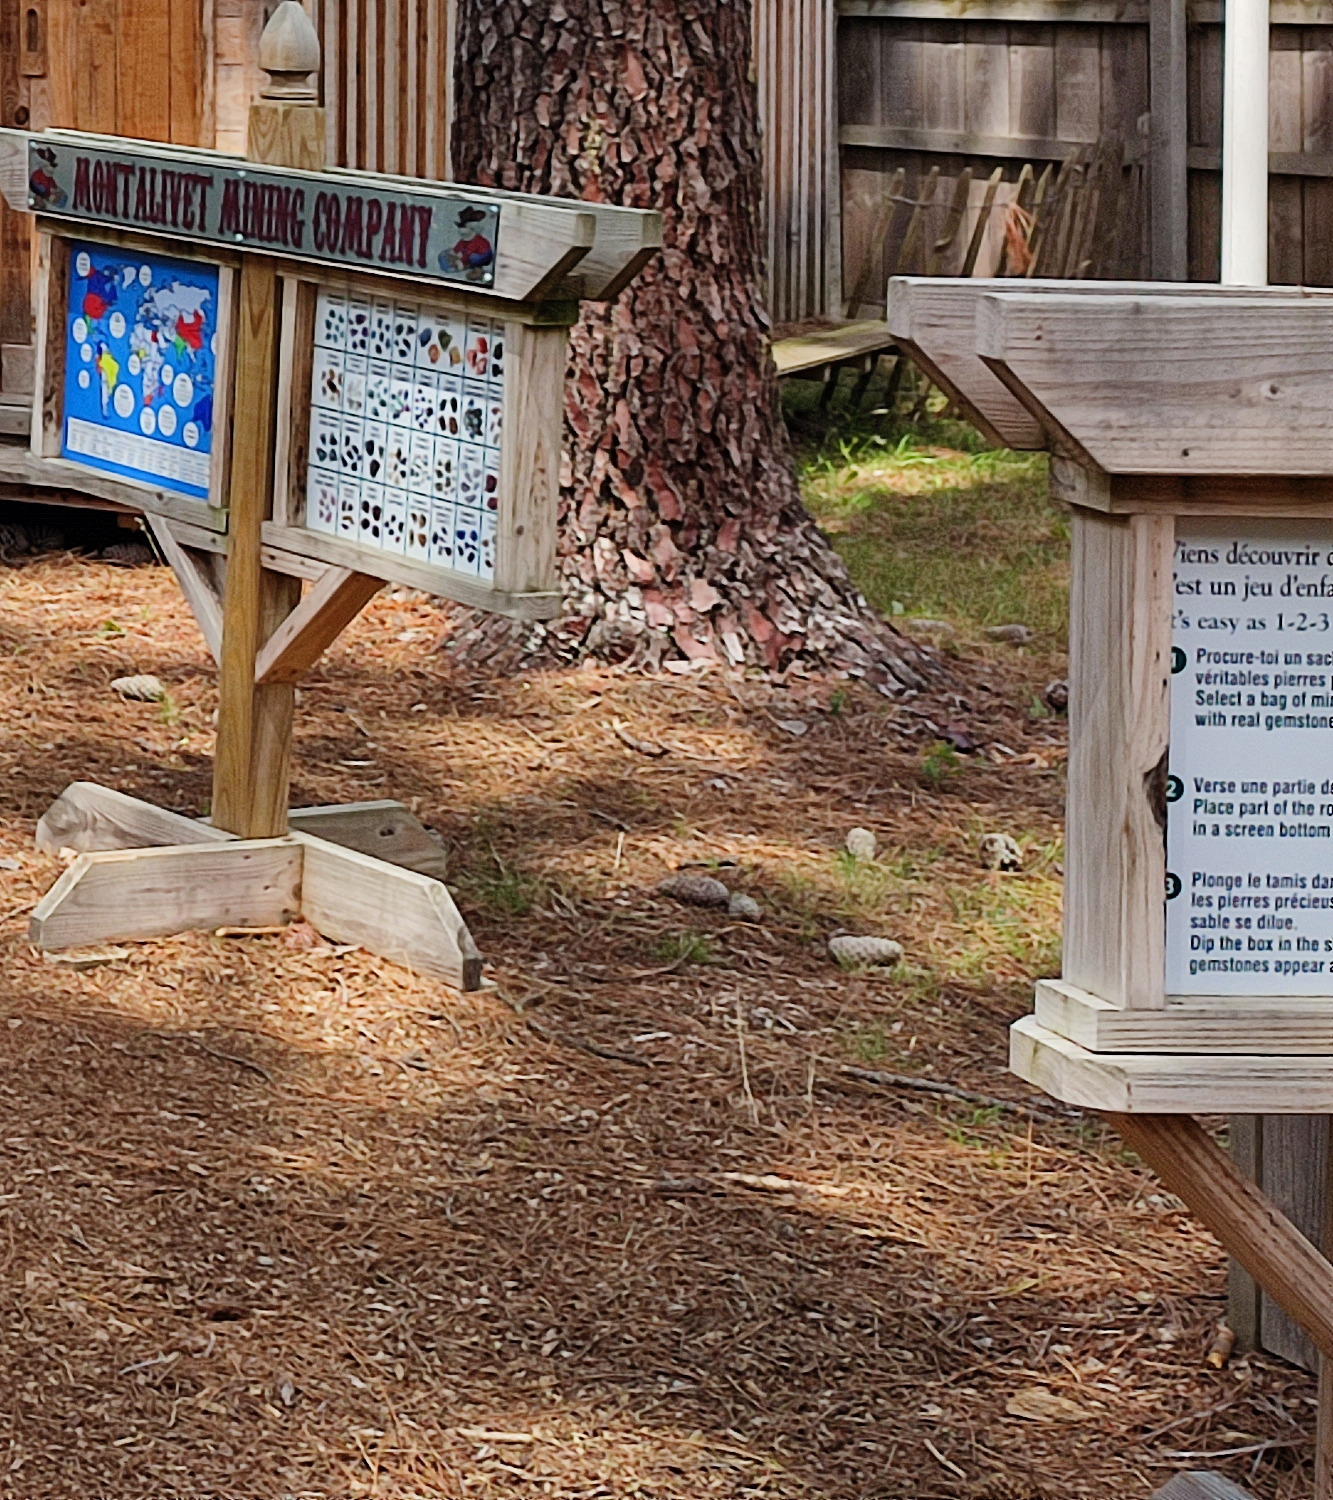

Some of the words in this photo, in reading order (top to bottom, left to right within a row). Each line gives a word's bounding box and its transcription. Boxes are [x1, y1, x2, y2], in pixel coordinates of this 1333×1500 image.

[72, 156, 214, 232] MONTALIVET
[218, 177, 306, 249] MINING
[312, 190, 433, 269] COMPANY
[1226, 541, 1320, 566] découvrir
[1172, 572, 1202, 595] 'est
[1210, 580, 1236, 596] un
[1241, 574, 1273, 602] jeu
[1171, 609, 1190, 629] t's
[1197, 615, 1238, 635] easy
[1246, 616, 1267, 630] as
[1276, 612, 1330, 632] 1-2-3
[1196, 648, 1279, 665] Procure-toi
[1284, 652, 1302, 665] un
[1306, 650, 1333, 666] sac
[1195, 669, 1269, 687] véritables
[1274, 670, 1326, 690] pierres
[1195, 689, 1242, 707] Select
[1246, 693, 1255, 706] a
[1260, 690, 1287, 711] bag
[1292, 691, 1307, 708] of
[1195, 711, 1226, 727] with
[1231, 712, 1260, 727] real
[1193, 777, 1236, 793] Verse
[1241, 781, 1268, 794] une
[1272, 779, 1316, 797] partie
[1193, 798, 1234, 816] Place
[1239, 800, 1269, 818] part
[1274, 799, 1288, 816] of
[1292, 800, 1315, 817] the
[1192, 820, 1206, 836] in
[1211, 824, 1220, 837] a
[1225, 823, 1274, 837] screen
[1279, 821, 1330, 838] bottom
[1192, 871, 1242, 891] Plonge
[1248, 872, 1261, 889] le
[1266, 873, 1307, 889] tamis
[1191, 892, 1213, 908] les
[1218, 893, 1270, 911] pierres
[1190, 913, 1230, 929] sable
[1235, 916, 1252, 929] se
[1190, 934, 1215, 953] Dip
[1220, 936, 1242, 951] the
[1247, 936, 1273, 951] box
[1278, 935, 1292, 951] in
[1296, 936, 1319, 952] the
[1189, 957, 1269, 974] gemstones
[1274, 959, 1325, 976] appear
